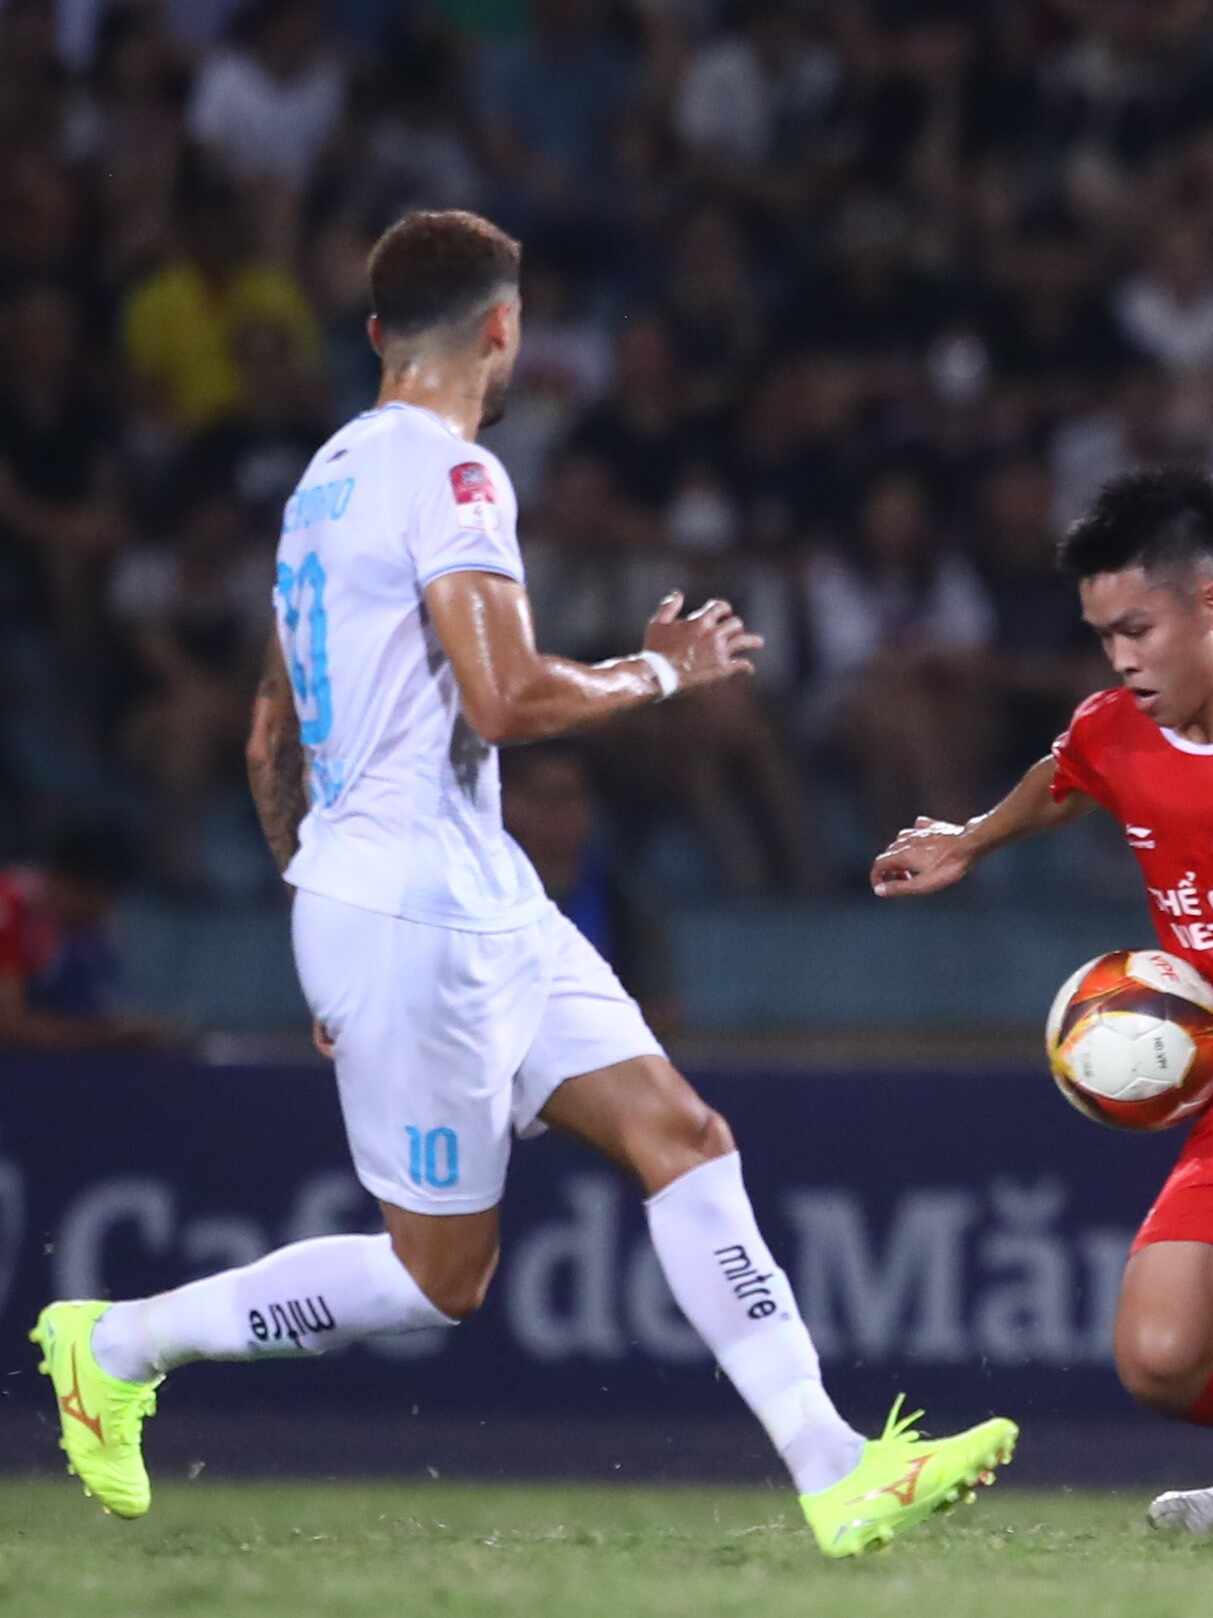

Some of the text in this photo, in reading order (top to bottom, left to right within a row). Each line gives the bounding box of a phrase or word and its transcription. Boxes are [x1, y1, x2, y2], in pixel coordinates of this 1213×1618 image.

[405, 1124, 459, 1189] 10
[714, 1244, 777, 1320] mitre
[249, 1295, 335, 1349] mitre
